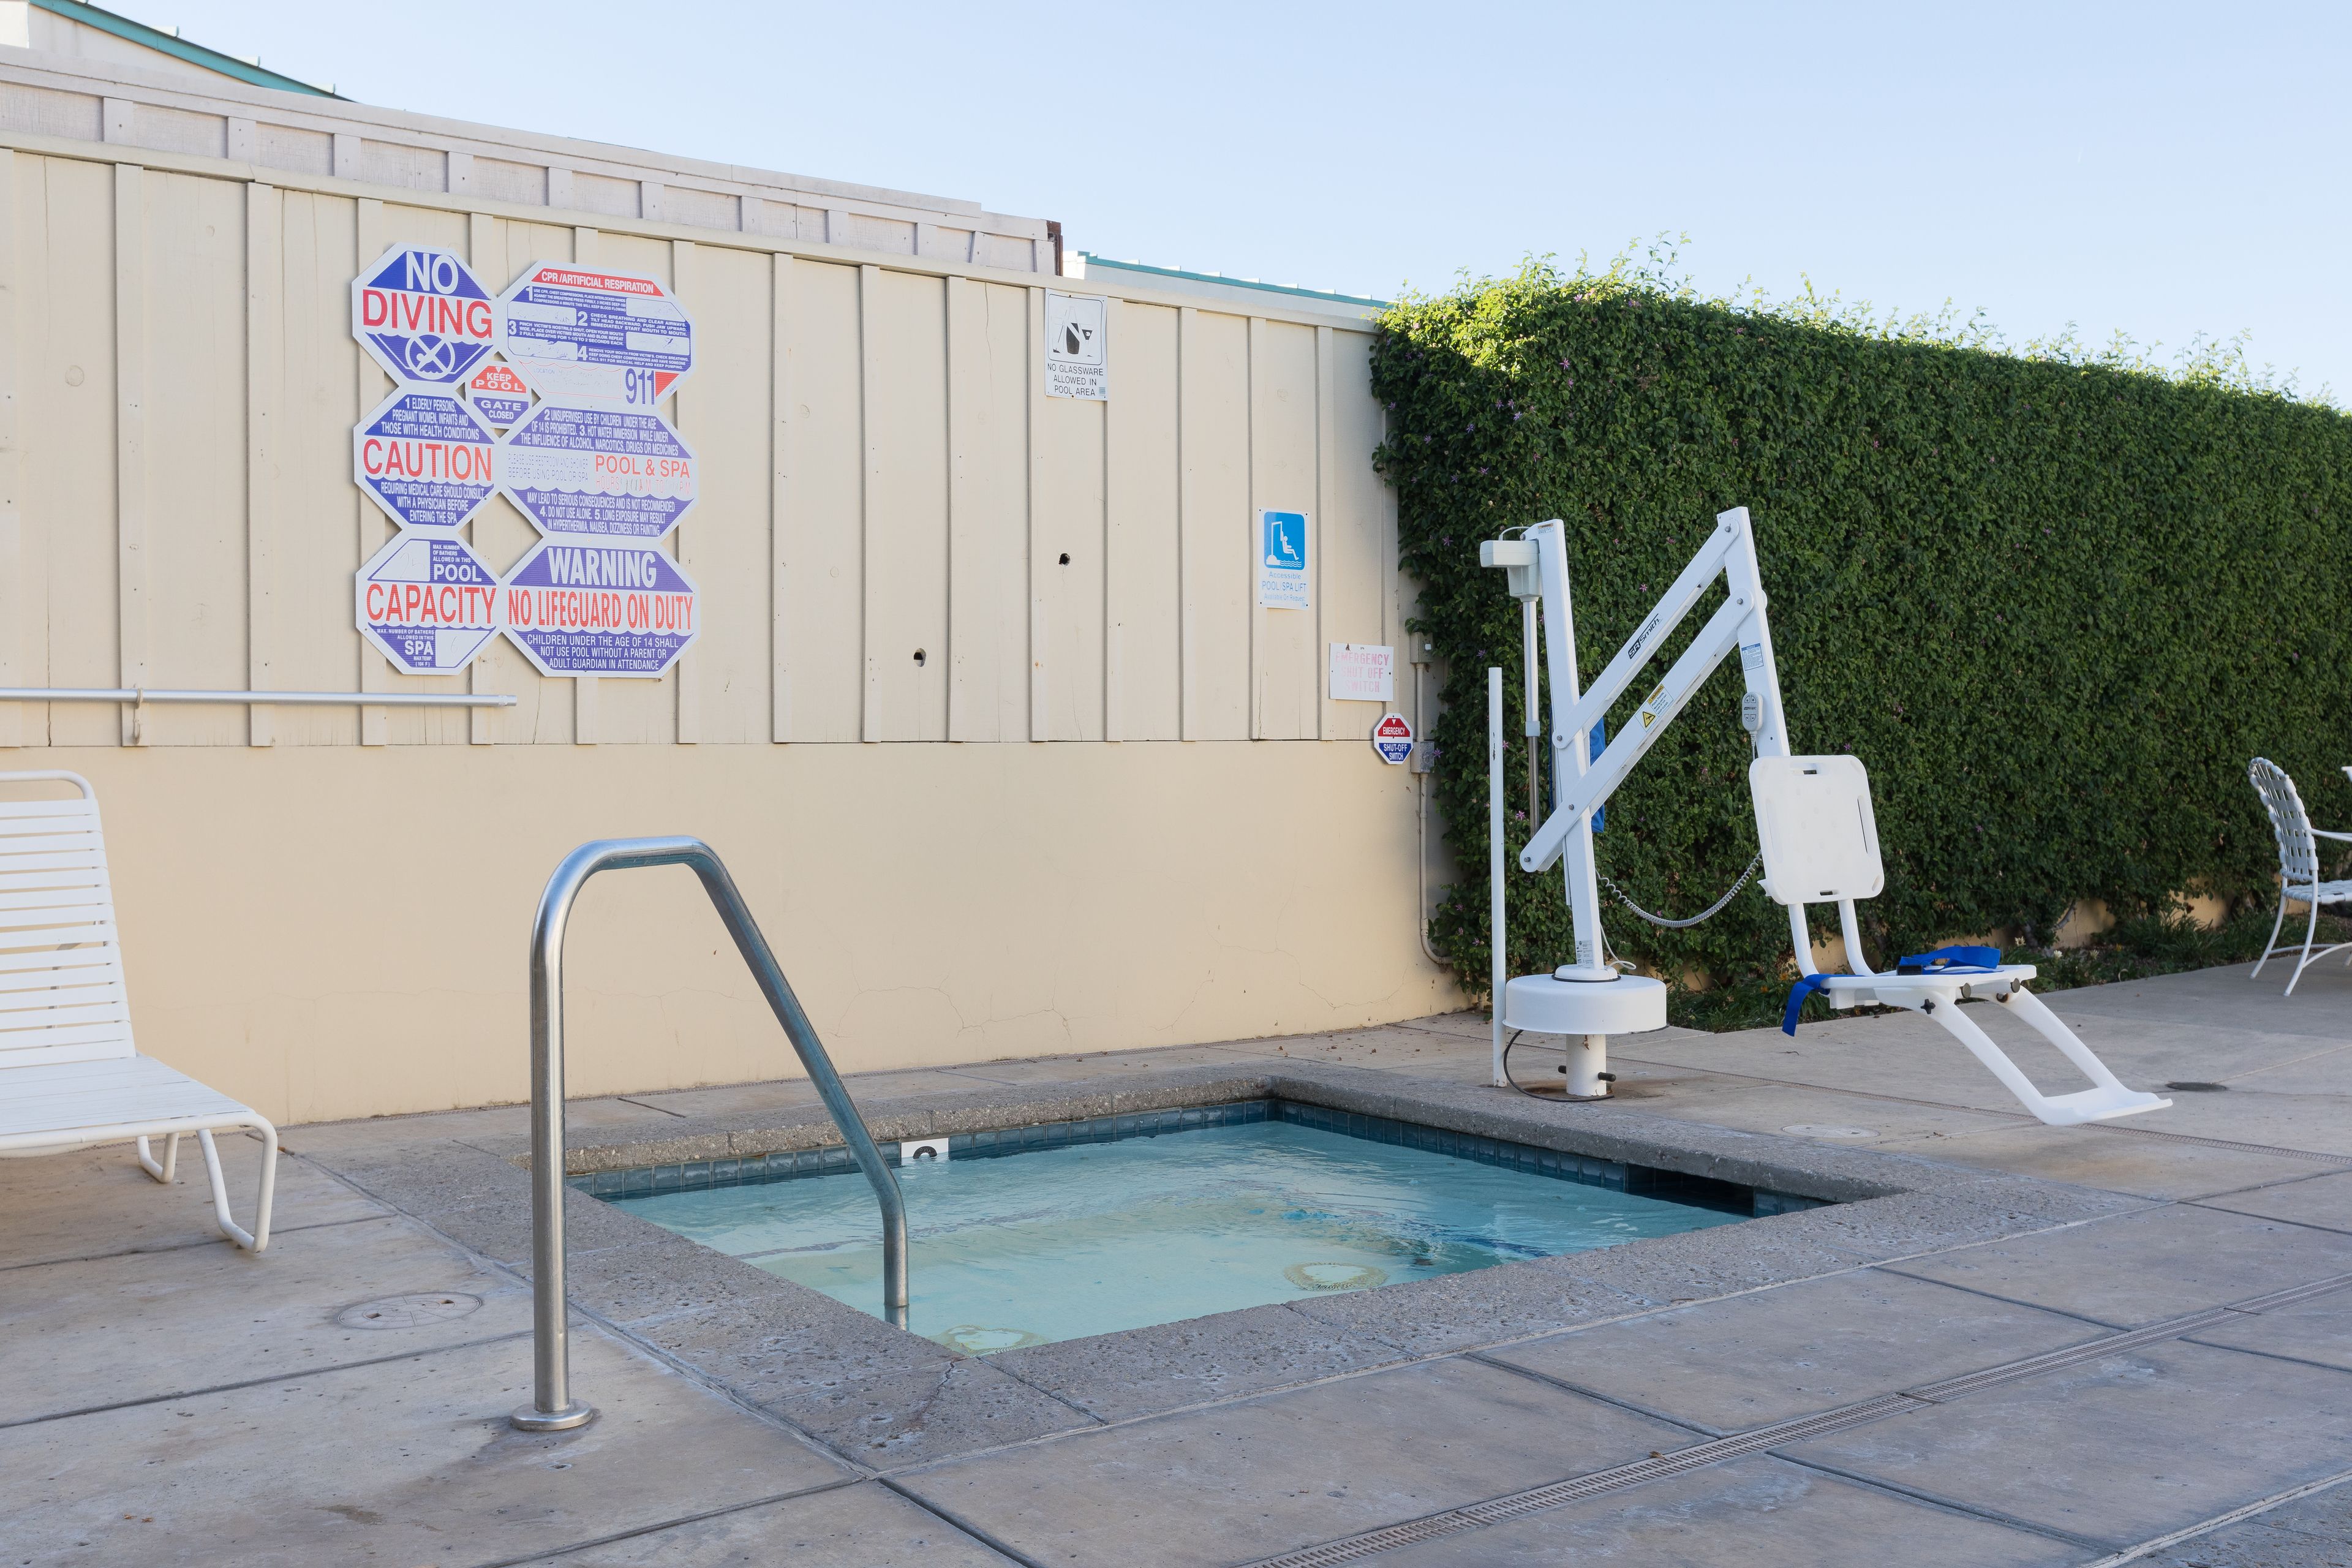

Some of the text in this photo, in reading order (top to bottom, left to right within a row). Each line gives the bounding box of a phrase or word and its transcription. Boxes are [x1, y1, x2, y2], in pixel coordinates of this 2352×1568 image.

[405, 251, 459, 294] NO
[541, 271, 557, 282] CPR
[605, 278, 653, 293] RESPIRATION
[526, 286, 533, 301] 1
[363, 288, 493, 339] DIVING
[578, 311, 588, 326] 2
[508, 321, 516, 334] 3
[578, 345, 587, 360] 4
[1060, 364, 1103, 376] GLASSWARE
[475, 380, 522, 391] POOL
[486, 372, 512, 390] KEEP
[625, 368, 655, 405] 911
[1054, 375, 1086, 385] ALLOWED
[1055, 385, 1095, 396] POOL AREA
[405, 397, 456, 413] 1 ELDERLY PERSONS,
[481, 399, 521, 411] GATE
[393, 409, 469, 426] PREGNANT WOMEN, INFANTS AND
[489, 409, 514, 420] CLOSED
[545, 409, 550, 421] 2
[551, 410, 583, 423] UNSUPERVISED
[584, 413, 593, 424] USE
[594, 413, 600, 424] BY
[600, 414, 622, 426] CHILDREN
[624, 417, 638, 428] UNDER
[639, 418, 647, 428] THE
[382, 422, 479, 440] THOSE WITH HEALTH CONDITIONS
[532, 421, 668, 442] OF 14 IS PROHIBITED. 3. HOT WATER IMMERSION WHILE UNDER
[521, 433, 678, 455] THE INFLUENCE OF ALCOHOL, NARCOTICS, DRUGS OR MEDICINES
[363, 439, 492, 481] CAUTION
[596, 454, 690, 478] POOL & SPA
[382, 482, 484, 499] REQUIRING MEDICAL CARE SHOULD CONSULT
[397, 496, 469, 511] WITH A PHYSICIAN BEFORE
[528, 492, 675, 512] MAY LEAD TO SERIOUS CONSEQUENCES AND IS NOT RECOMMENDED
[410, 510, 457, 523] ENTERING THE SPA
[540, 507, 666, 524] 4. DO NOT USE ALONE. 5. LONG EXPOSURE MAY RESULT
[547, 518, 660, 535] IN HYPERTHERMIA, NAUSEA, DIZZINESS OR FAINTING
[434, 564, 482, 582] POOL
[548, 548, 657, 588] WARNING
[1295, 583, 1306, 592] LIFT
[366, 584, 496, 625] CAPACITY
[508, 589, 693, 630] NO LIFEGUARD ON DUTY
[404, 641, 434, 655] SPA
[527, 635, 679, 648] CHILDREN UNDER THE AGE OF 14 SHALL
[541, 646, 666, 658] NOT USE POOL WITHOUT A PARENT OR
[1335, 652, 1390, 666] EMERGENCY
[549, 658, 658, 670] ADULT GUARDIAN IN ATTENDANCE
